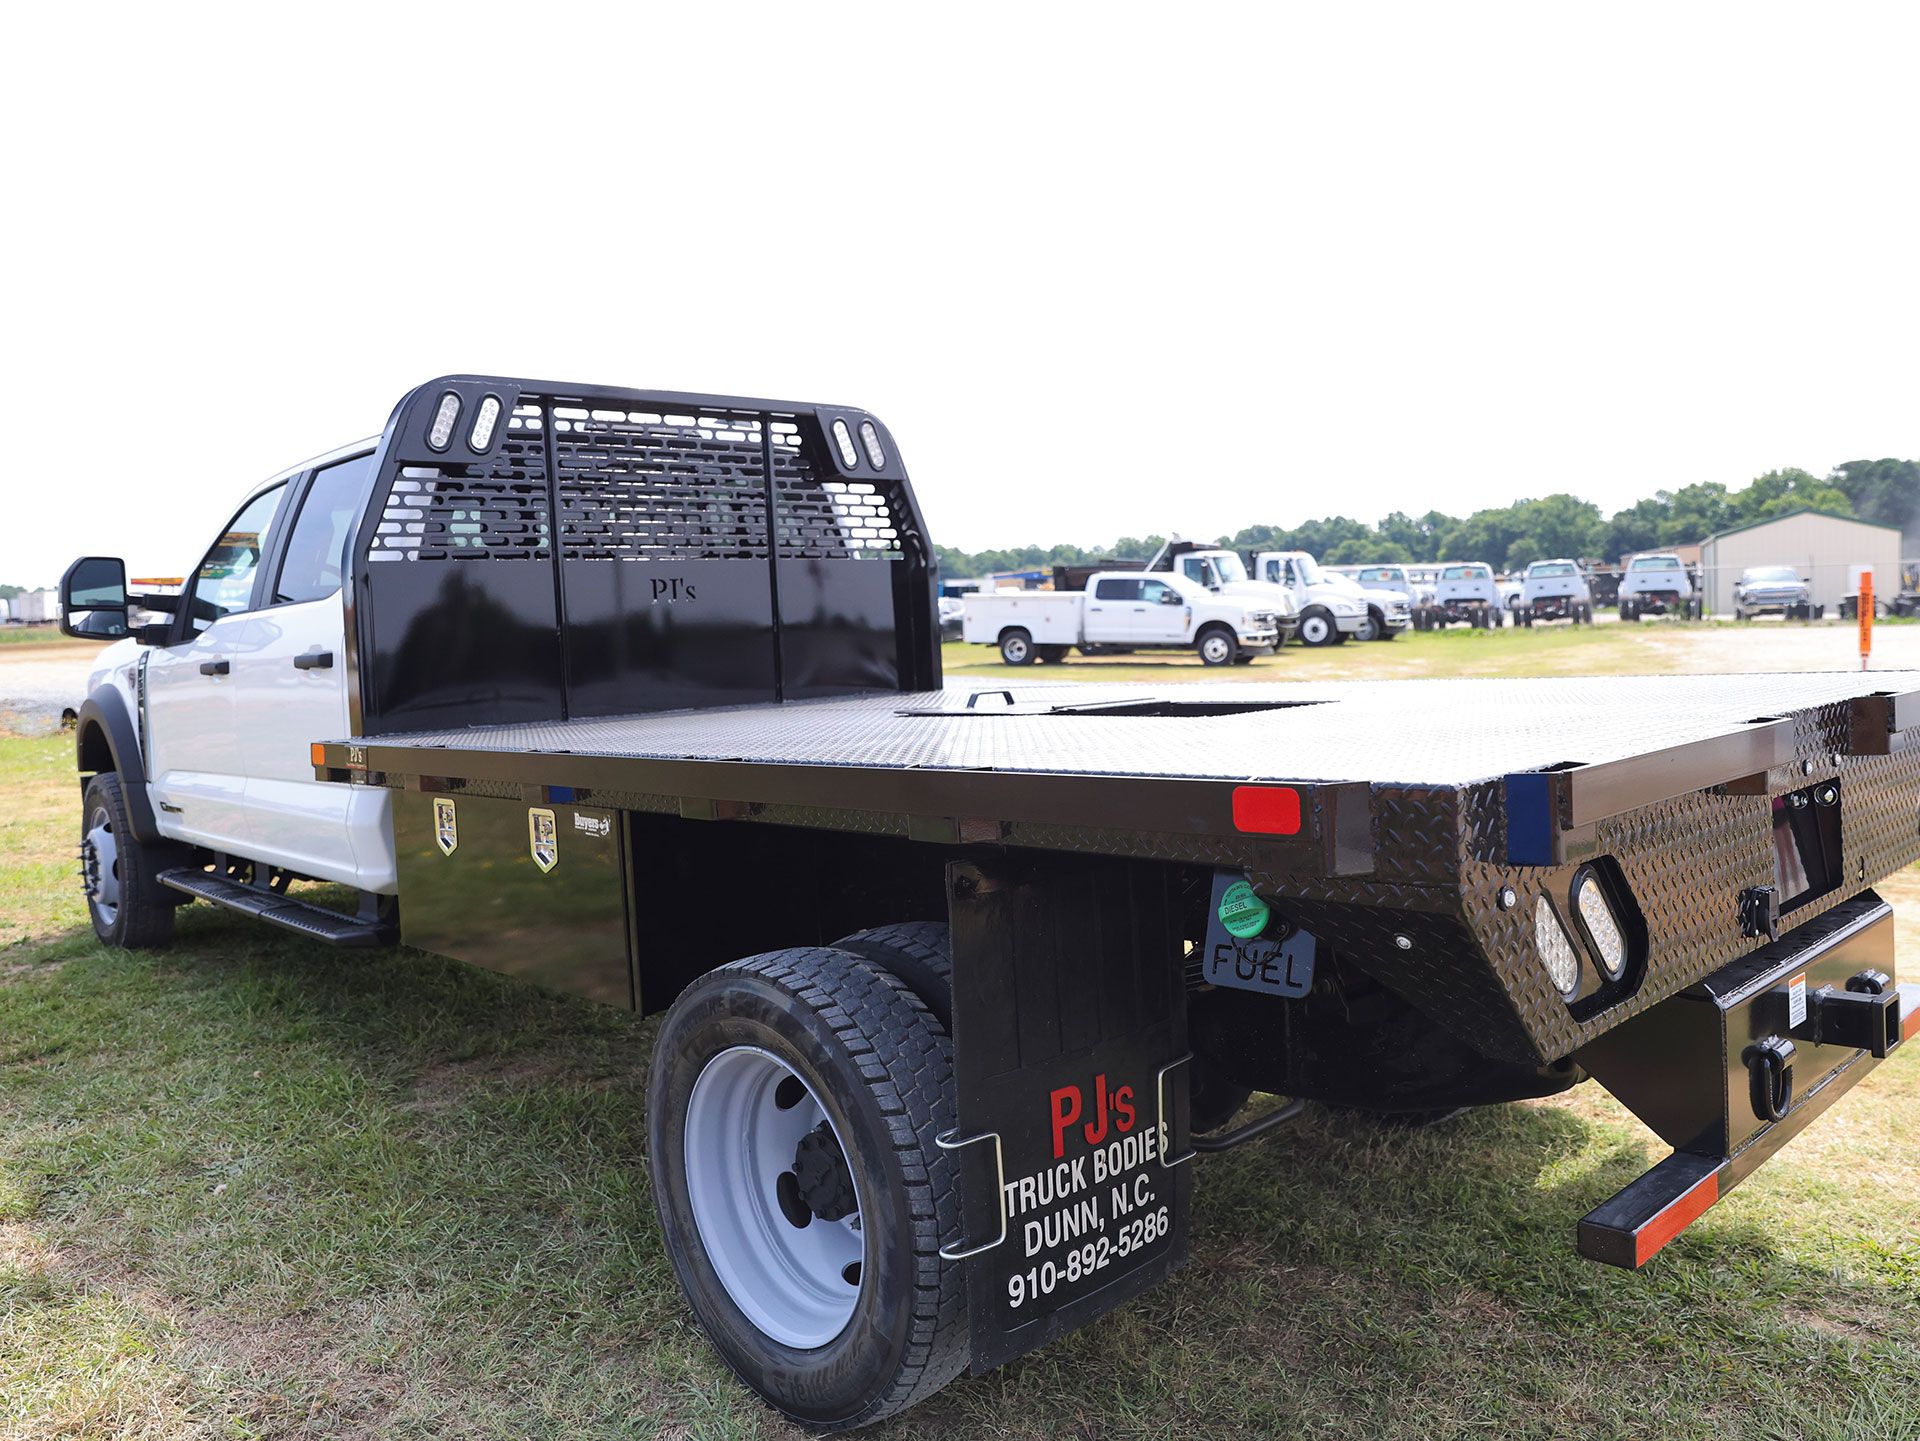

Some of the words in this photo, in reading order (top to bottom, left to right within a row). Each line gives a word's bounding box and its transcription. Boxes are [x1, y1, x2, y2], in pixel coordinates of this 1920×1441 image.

[649, 577, 697, 603] PJ's
[1224, 902, 1248, 915] DIESEL
[1212, 945, 1302, 988] FUEL
[1004, 1156, 1087, 1217] TRUCK
[1094, 1122, 1169, 1184] BODIES
[1024, 1197, 1106, 1257] DUNN,
[1112, 1173, 1155, 1220] N.C.
[1008, 1207, 1169, 1308] 910-892-5286
